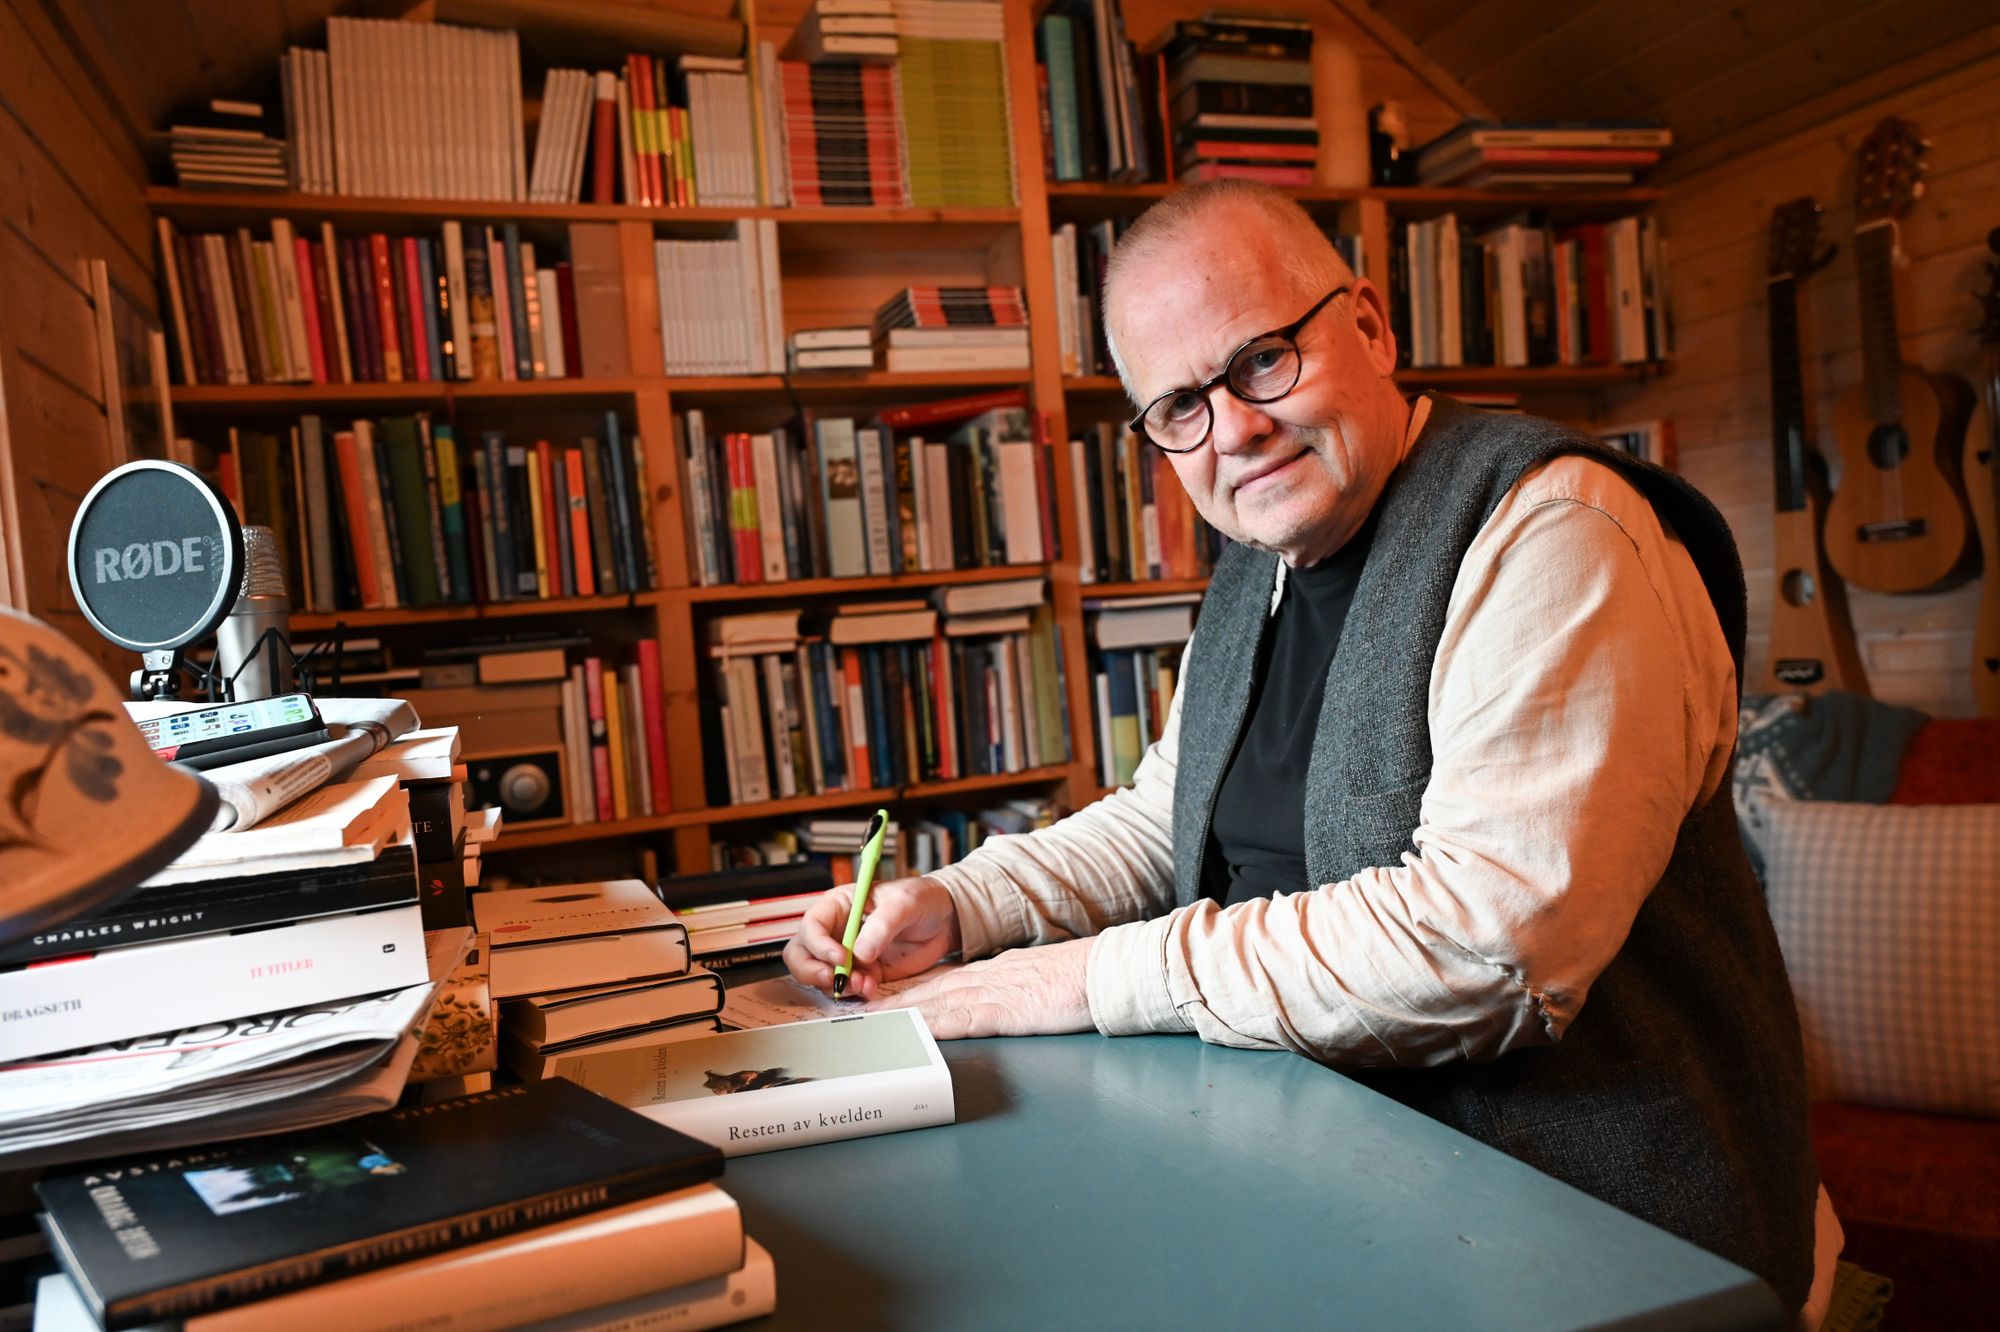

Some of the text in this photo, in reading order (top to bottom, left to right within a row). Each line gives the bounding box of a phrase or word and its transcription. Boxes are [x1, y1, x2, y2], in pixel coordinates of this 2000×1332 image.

[32, 911, 206, 947] CHARLES WRIGHT
[267, 958, 315, 978] TITLER
[1, 999, 83, 1024] DRAGSETH
[728, 1107, 884, 1142] Resten av kvelden
